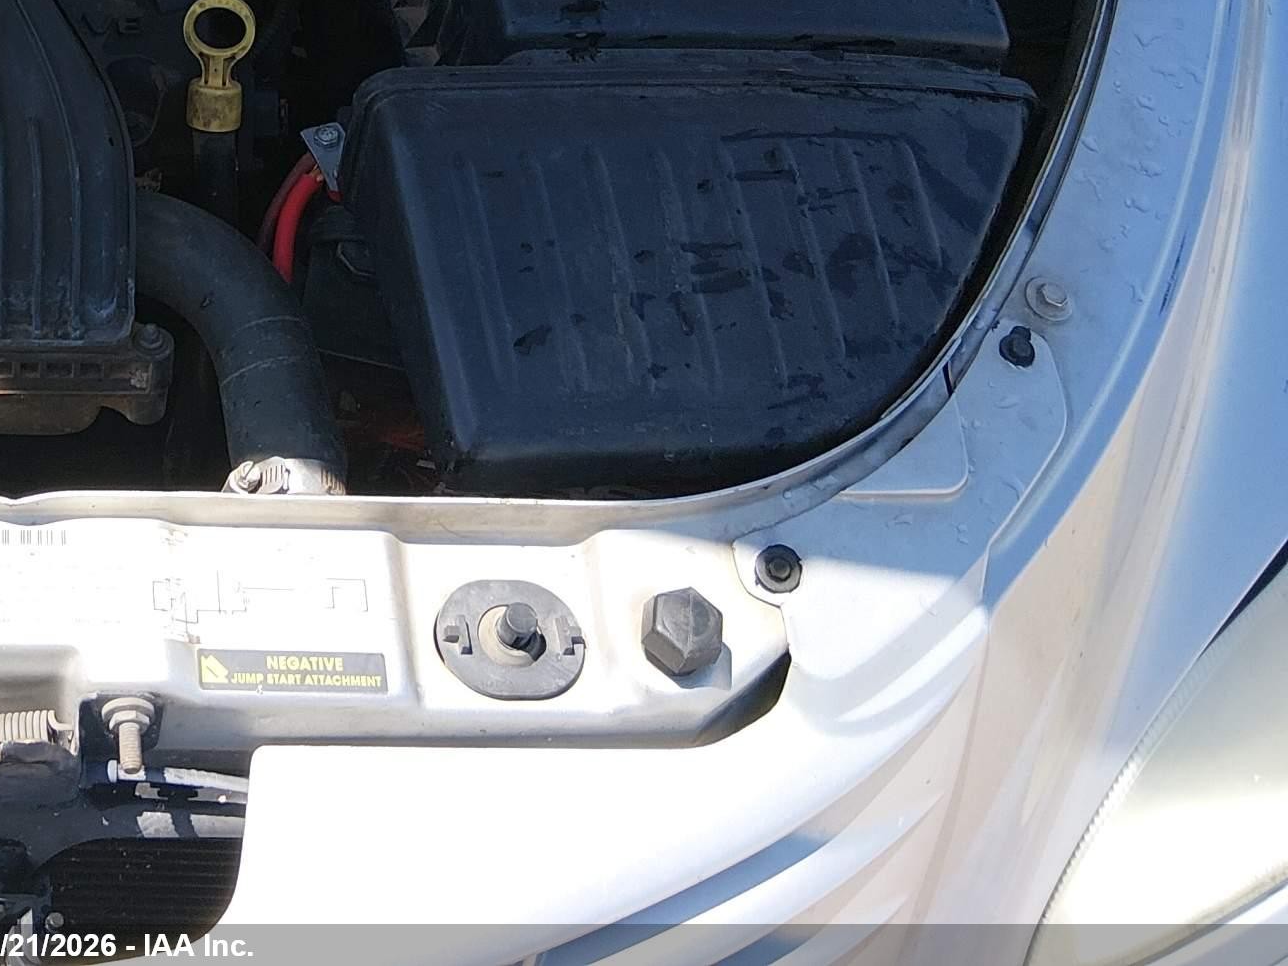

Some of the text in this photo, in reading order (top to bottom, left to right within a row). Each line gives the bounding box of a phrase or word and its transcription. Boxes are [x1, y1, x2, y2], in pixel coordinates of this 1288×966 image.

[265, 655, 344, 672] NEGATIVE
[231, 672, 382, 688] JUMP START ATTACHMENT
